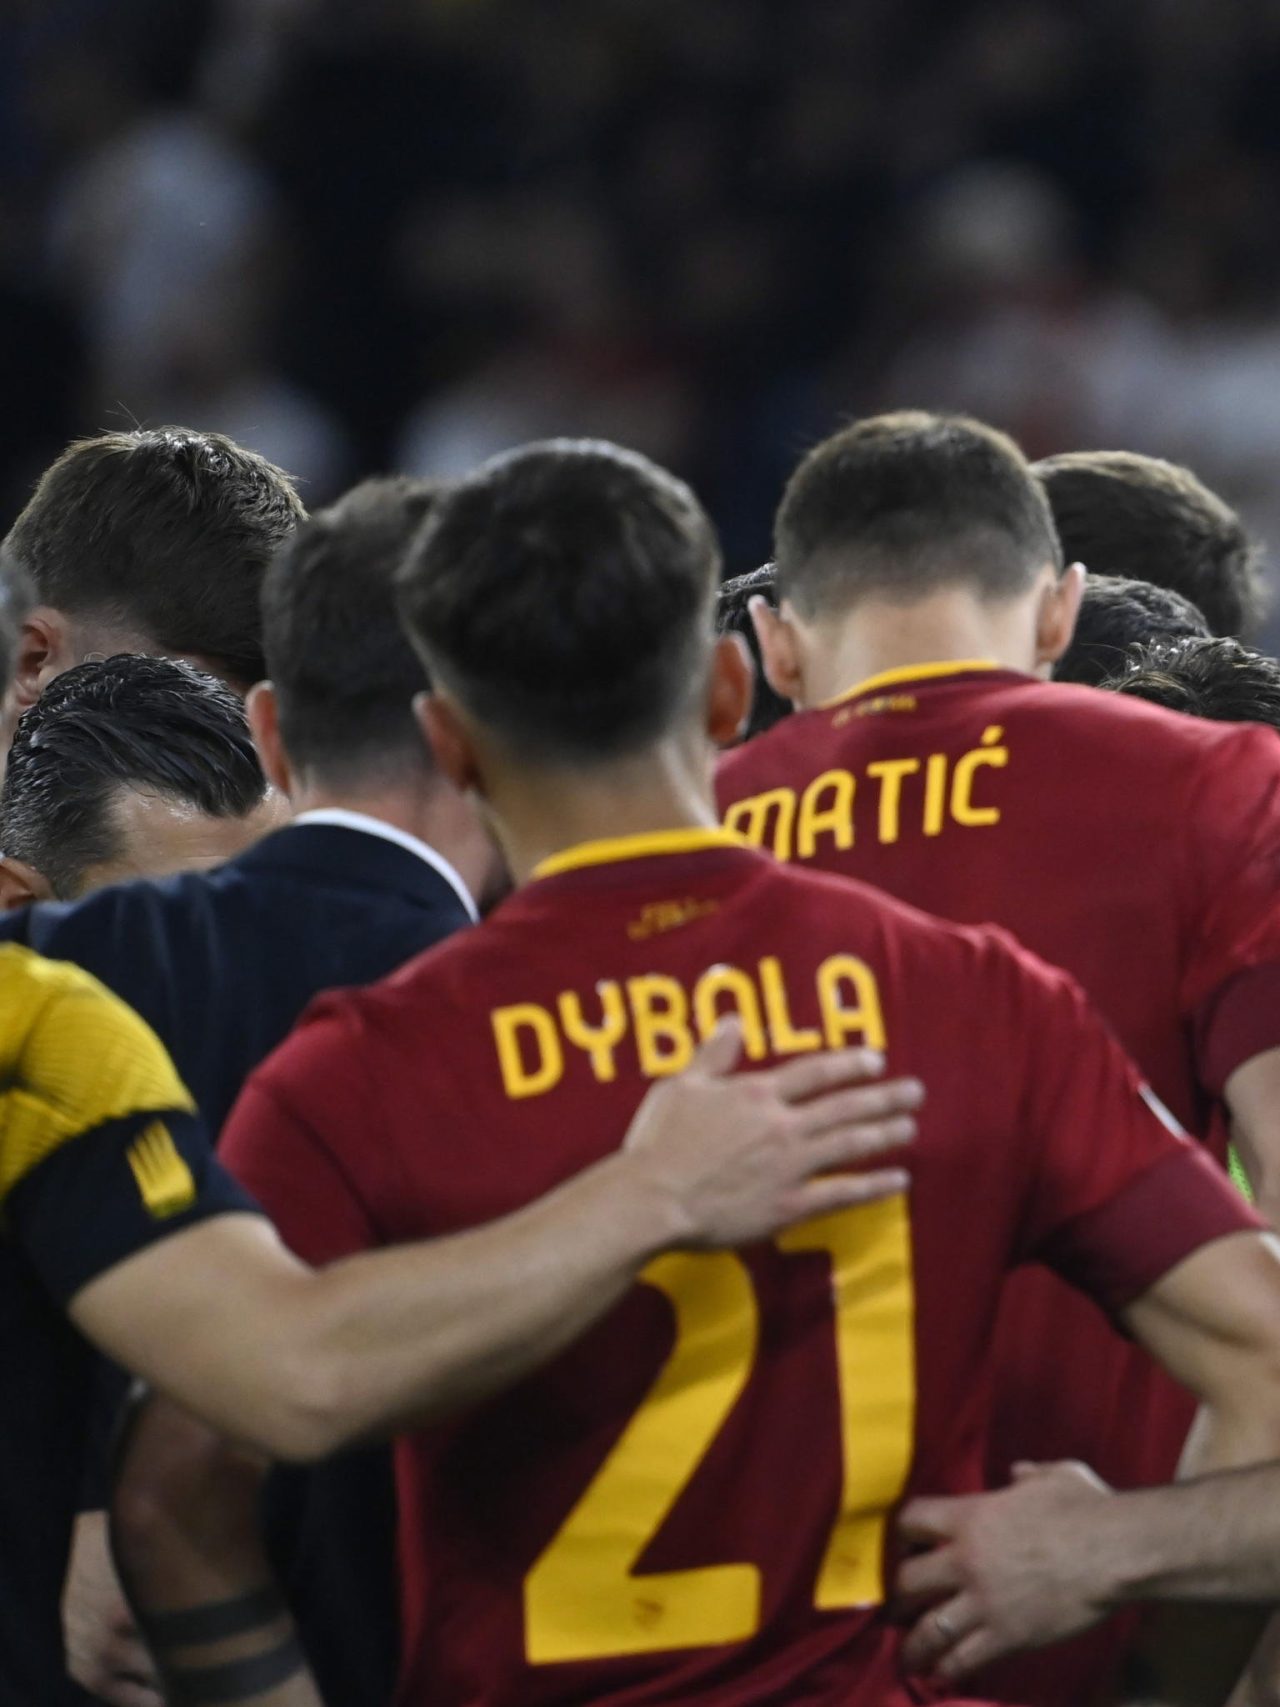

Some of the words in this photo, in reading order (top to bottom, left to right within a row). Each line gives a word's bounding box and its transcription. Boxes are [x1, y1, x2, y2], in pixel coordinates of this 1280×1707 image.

[723, 725, 1008, 864] MATIĆ
[491, 954, 887, 1098] DYBALA
[523, 1174, 917, 1667] 21
